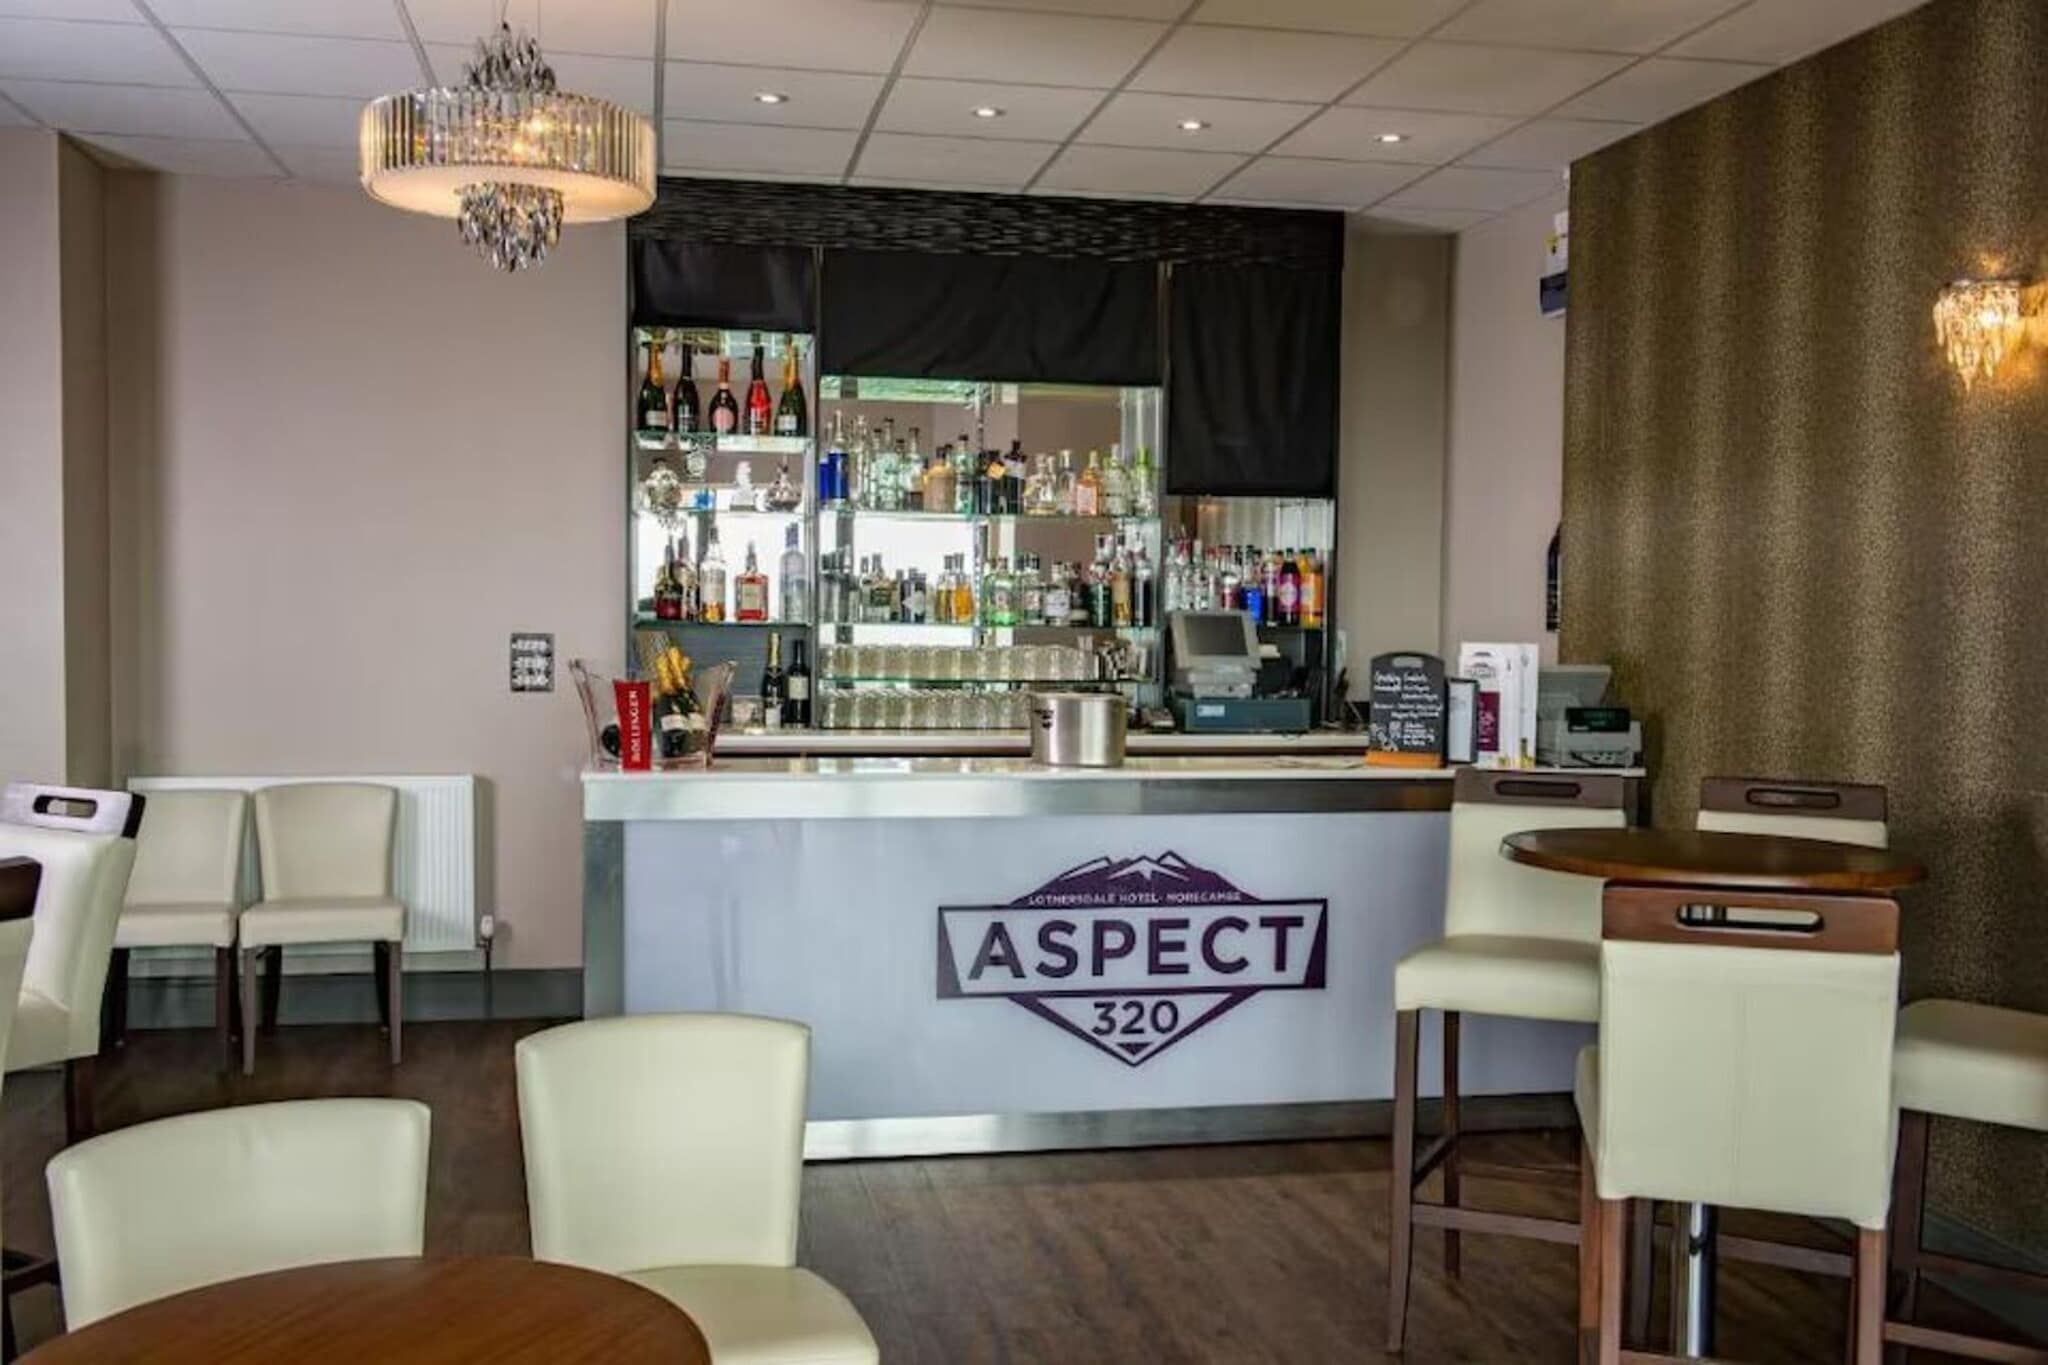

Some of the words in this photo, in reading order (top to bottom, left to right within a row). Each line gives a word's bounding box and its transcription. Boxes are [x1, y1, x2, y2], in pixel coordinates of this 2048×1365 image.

[1119, 892, 1159, 904] HOTEL
[967, 916, 1304, 980] ASPECT
[1091, 1000, 1179, 1036] 320
